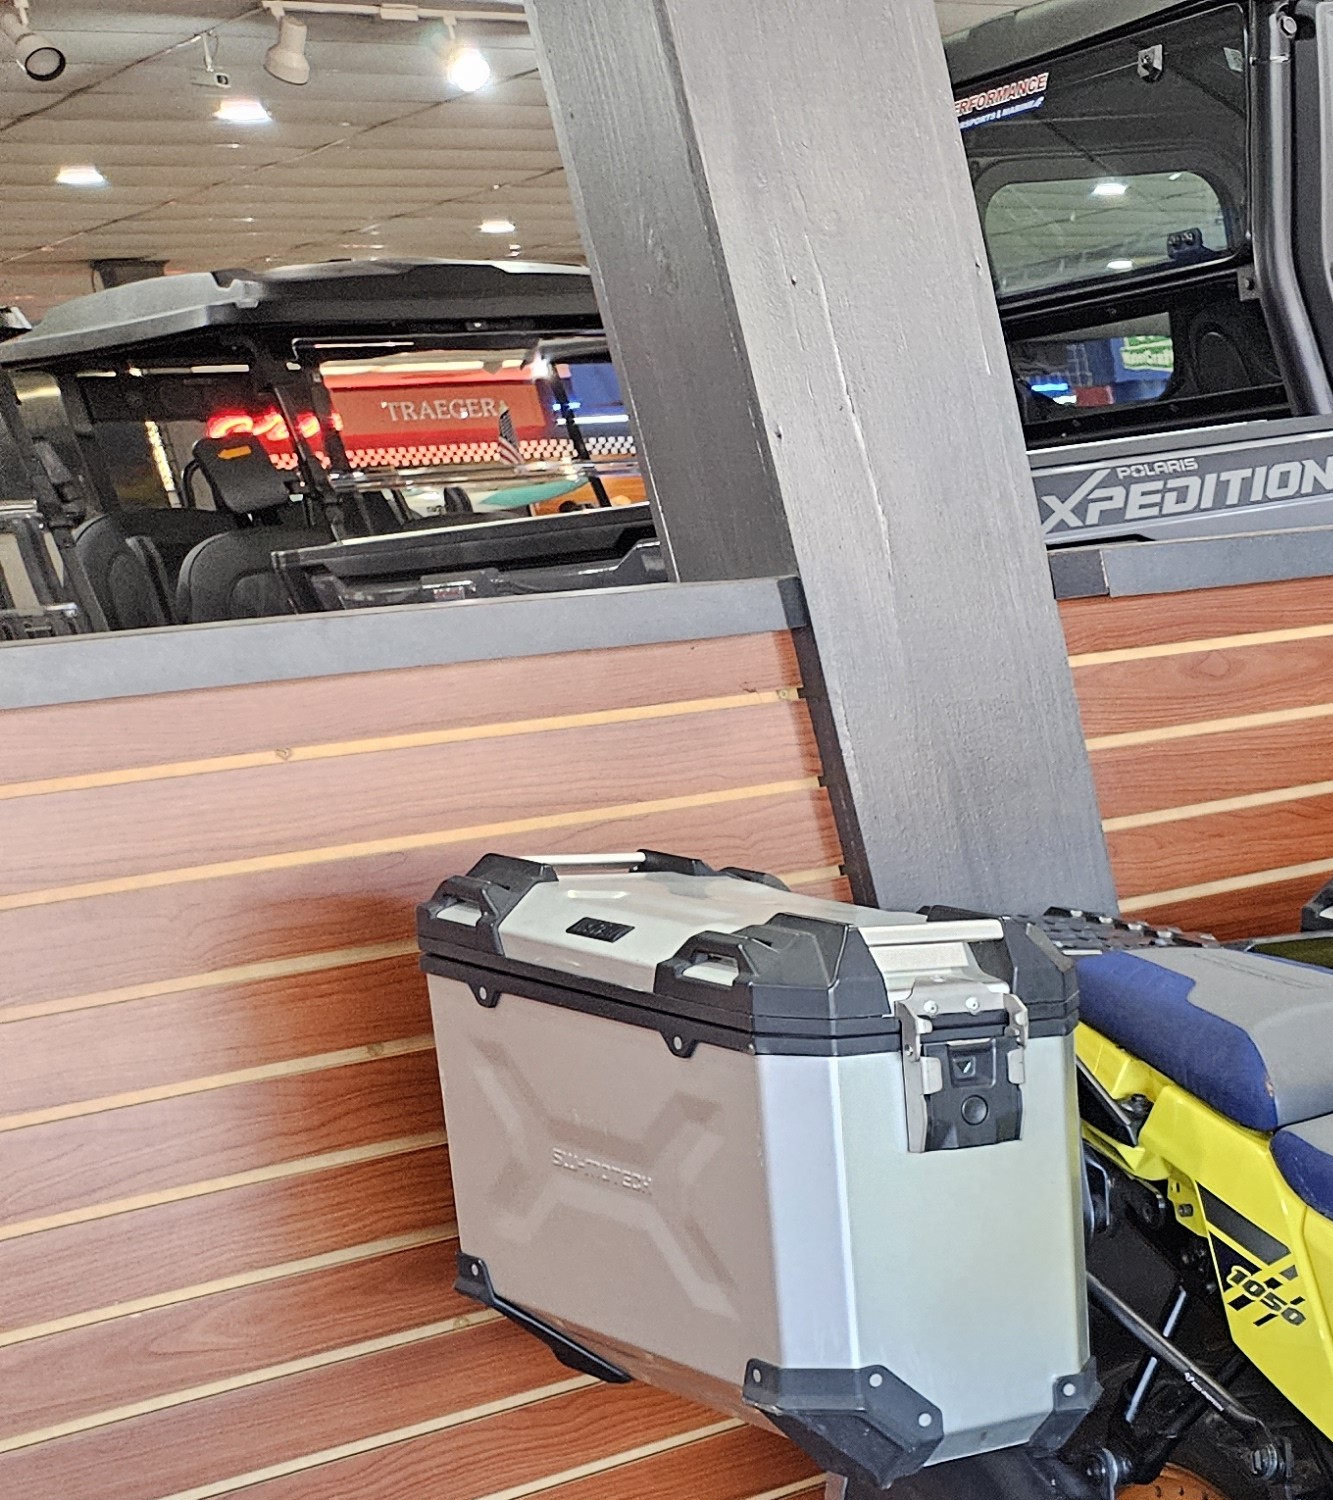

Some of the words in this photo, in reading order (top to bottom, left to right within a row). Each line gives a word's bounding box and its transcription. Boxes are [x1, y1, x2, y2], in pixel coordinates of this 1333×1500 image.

[955, 72, 1049, 117] ERFORMANCE
[386, 398, 501, 422] TRAEGER
[1116, 457, 1199, 480] POLARIS
[1226, 1266, 1307, 1326] 1050
